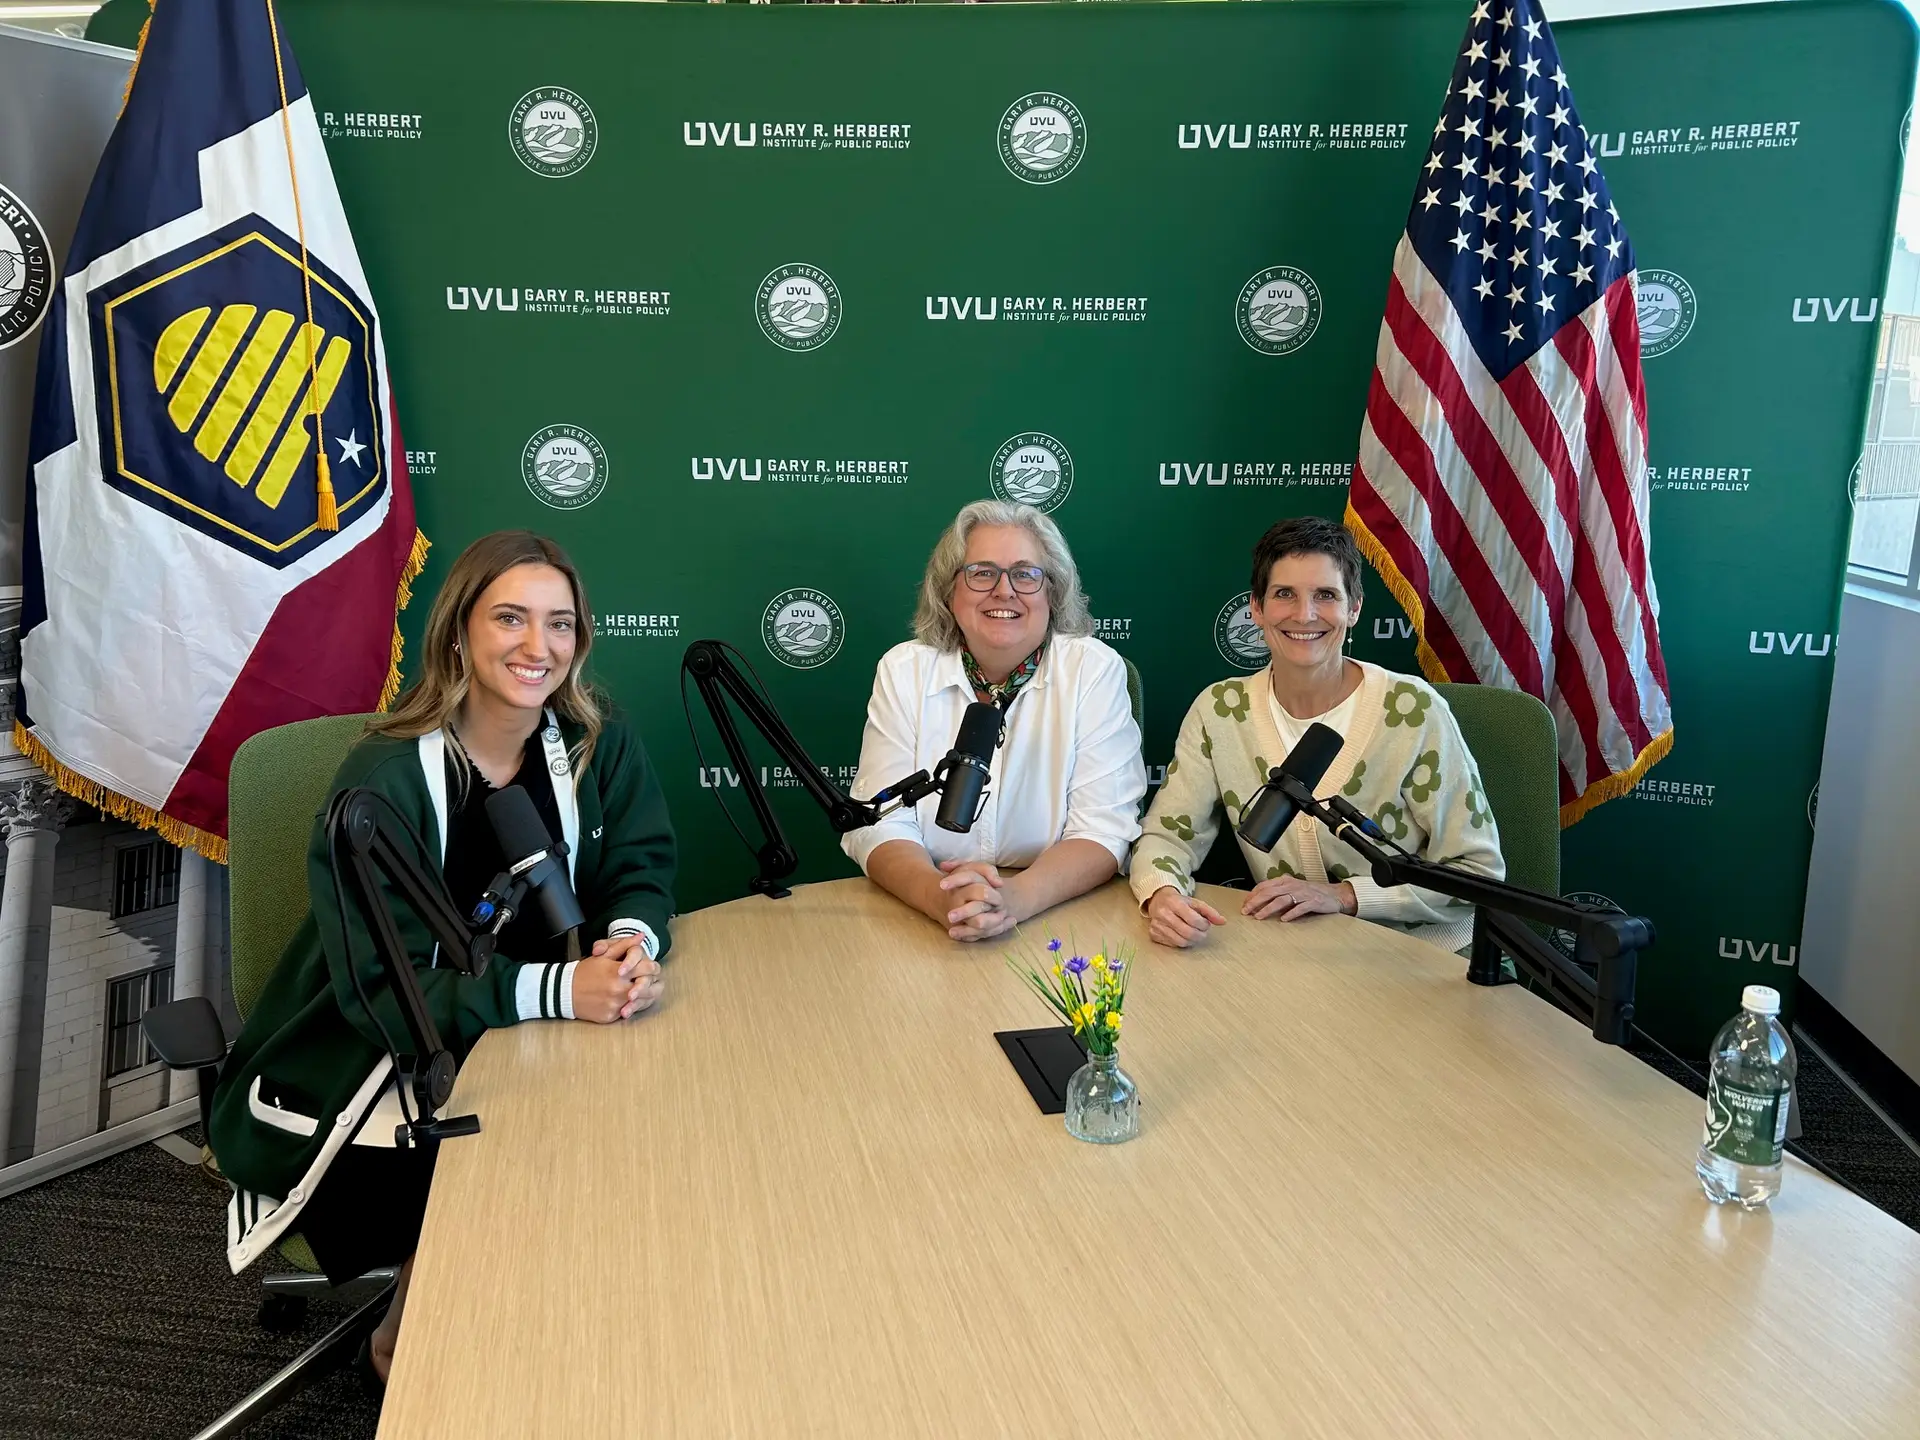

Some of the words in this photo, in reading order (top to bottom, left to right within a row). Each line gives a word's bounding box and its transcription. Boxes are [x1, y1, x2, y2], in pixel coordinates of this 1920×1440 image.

[515, 98, 532, 123] GARY
[552, 90, 592, 123] HERBERT
[541, 111, 566, 120] UVU
[1004, 104, 1022, 130] GARY
[1043, 96, 1082, 128] HERBERT
[324, 112, 339, 125] R.
[344, 113, 422, 128] HERBERT
[1030, 117, 1055, 126] UVU
[330, 128, 344, 138] for
[346, 128, 383, 138] PUBLIC
[387, 130, 422, 138] POLICY
[684, 122, 757, 146] UVU
[763, 124, 806, 136] GARY
[814, 124, 828, 136] R.
[834, 124, 911, 138] HERBERT
[1178, 125, 1252, 148] UVU
[1258, 124, 1302, 137] GARY
[1309, 124, 1324, 137] R.
[1330, 124, 1408, 137] HERBERT
[1632, 129, 1681, 145] GARY
[1688, 127, 1705, 140] R.
[1711, 121, 1800, 140] HERBERT
[515, 136, 540, 168] INSTITUTE
[577, 140, 592, 163] POLICY
[763, 139, 817, 148] INSTITUTE
[819, 139, 832, 150] for
[835, 140, 871, 148] PUBLIC
[876, 140, 911, 149] POLICY
[1257, 140, 1311, 149] INSTITUTE
[1313, 140, 1327, 151] for
[1329, 140, 1367, 149] PUBLIC
[1370, 140, 1406, 148] POLICY
[1631, 143, 1690, 155] INSTITUTE
[1692, 142, 1708, 154] for
[1711, 139, 1753, 150] PUBLIC
[1757, 138, 1798, 148] POLICY
[1003, 144, 1028, 175] INSTITUTE
[1064, 145, 1080, 169] POLICY
[24, 244, 43, 308] POLICY
[761, 275, 779, 298] GARY
[799, 267, 837, 298] HERBERT
[787, 287, 811, 295] UVU
[1242, 278, 1262, 303] GARY
[1282, 270, 1317, 301] HERBERT
[1268, 290, 1292, 298] UVU
[1652, 273, 1692, 304] HERBERT
[446, 287, 519, 311] UVU
[525, 289, 567, 302] GARY
[575, 290, 589, 302] R.
[595, 290, 670, 305] HERBERT
[1003, 298, 1046, 310] GARY
[1053, 298, 1067, 310] R.
[1072, 297, 1148, 311] HERBERT
[525, 304, 578, 313] INSTITUTE
[580, 304, 594, 315] for
[596, 305, 633, 314] PUBLIC
[636, 306, 670, 315] POLICY
[926, 297, 997, 320] UVU
[1003, 312, 1055, 321] INSTITUTE
[1057, 312, 1070, 323] for
[1073, 313, 1109, 321] PUBLIC
[1112, 313, 1147, 321] POLICY
[1792, 297, 1878, 322] UVU
[761, 312, 785, 343] INSTITUTE
[821, 314, 836, 337] POLICY
[1240, 316, 1263, 346] INSTITUTE
[1299, 318, 1316, 340] POLICY
[1670, 320, 1689, 343] POLICY
[527, 435, 545, 458] GARY
[564, 428, 603, 458] HERBERT
[996, 444, 1014, 467] GARY
[1033, 436, 1069, 466] HERBERT
[691, 457, 762, 481] UVU
[768, 460, 810, 472] GARY
[816, 460, 830, 472] R.
[836, 460, 909, 474] HERBERT
[1021, 455, 1044, 463] UVU
[768, 474, 819, 482] INSTITUTE
[821, 474, 835, 485] for
[837, 474, 872, 483] PUBLIC
[875, 475, 908, 484] POLICY
[1159, 463, 1228, 485] UVU
[1234, 464, 1275, 475] GARY
[1282, 464, 1295, 475] R.
[1300, 464, 1354, 475] HERBE
[1648, 467, 1661, 479] R.
[1667, 467, 1752, 480] HERBERT
[527, 471, 552, 502] INSTITUTE
[588, 473, 603, 496] POLICY
[1054, 481, 1068, 503] POLICY
[1233, 478, 1284, 486] INSTITUTE
[1285, 478, 1298, 488] for
[1301, 478, 1335, 486] PUBLIC
[1651, 481, 1664, 492] for
[1667, 482, 1707, 490] PUBLIC
[1711, 483, 1749, 491] POLICY
[767, 599, 785, 621] GARY
[803, 592, 840, 620] HERBERT
[1220, 601, 1239, 624] GARY
[606, 615, 680, 627] HERBERT
[1094, 619, 1132, 630] BERT
[1374, 618, 1414, 638] UV
[825, 634, 839, 655] POLICY
[1220, 634, 1240, 662] INSTITUTE
[1749, 631, 1831, 656] UVU
[774, 767, 797, 778] GA
[1636, 779, 1716, 797] HERBERT
[1636, 792, 1673, 803] PUBLIC
[1677, 796, 1714, 806] POLICY
[1719, 936, 1796, 967] UVU
[1724, 1089, 1773, 1106] WOLVERINE
[1732, 1099, 1763, 1112] WATER
